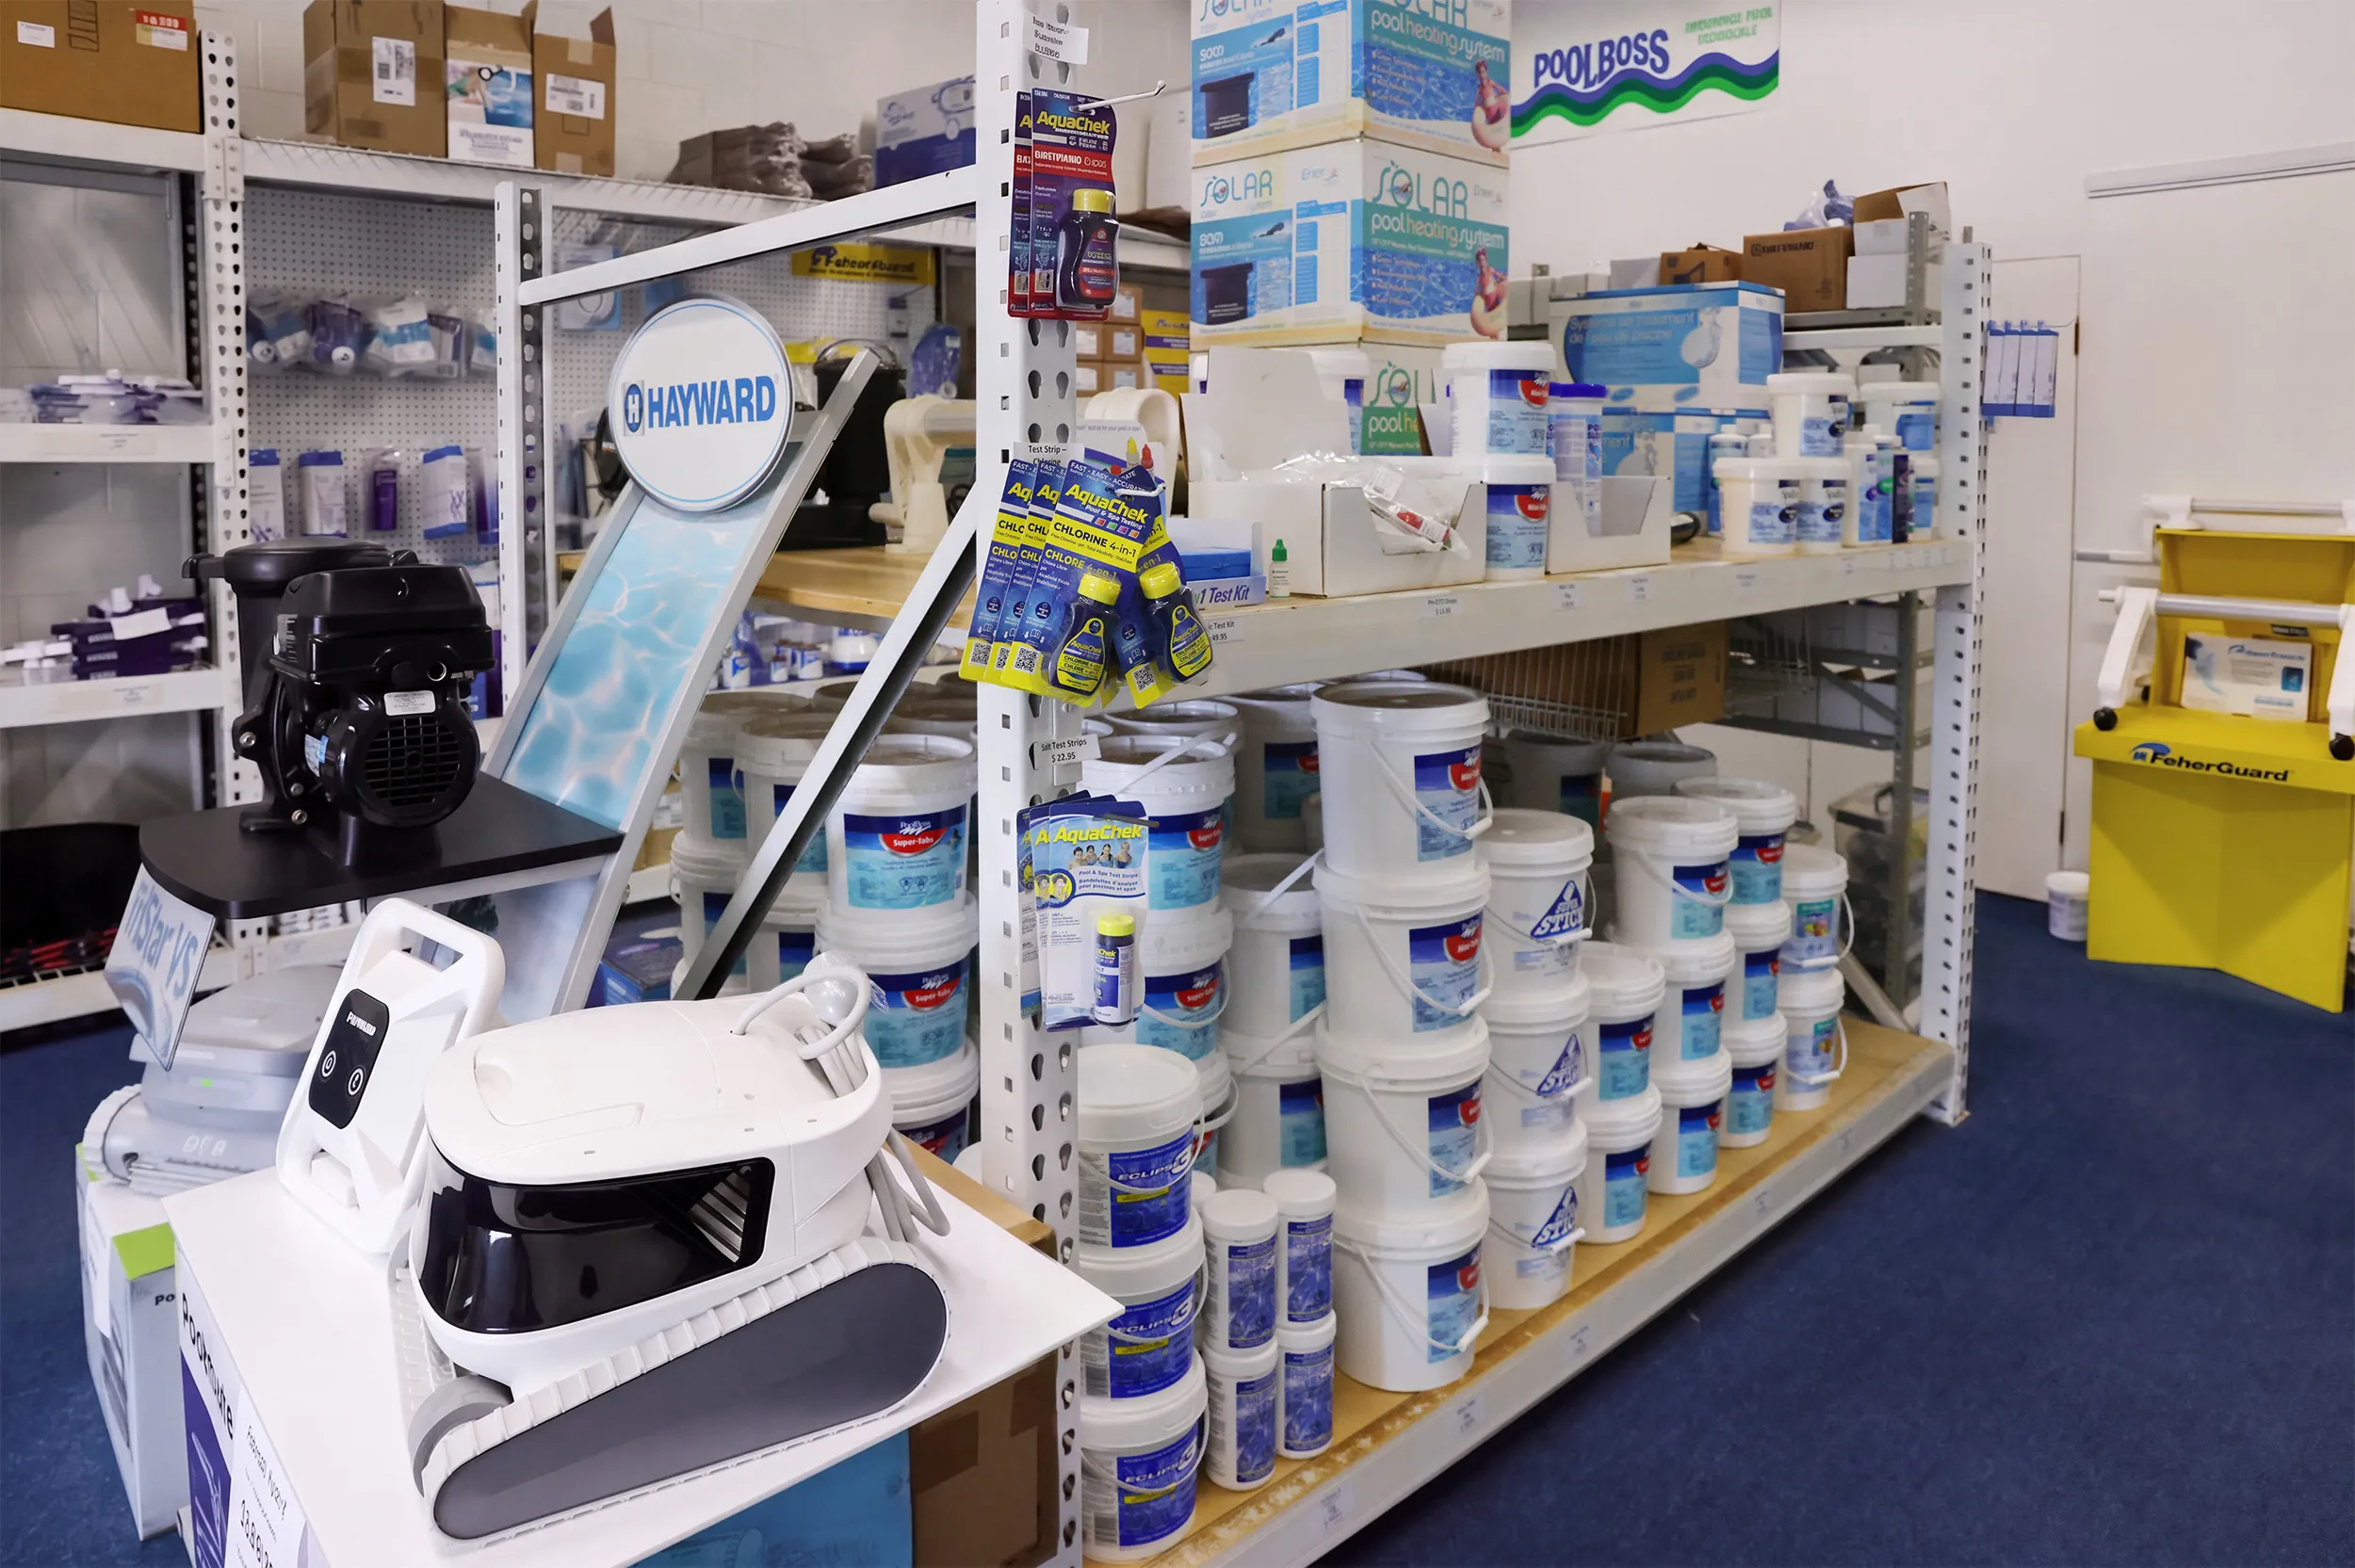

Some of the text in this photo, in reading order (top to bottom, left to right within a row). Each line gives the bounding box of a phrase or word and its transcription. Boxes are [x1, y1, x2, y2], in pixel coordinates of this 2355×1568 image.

[1372, 9, 1405, 34] pool
[1405, 13, 1458, 55] heating
[1458, 36, 1505, 63] system
[1036, 111, 1110, 135] AquaChek
[1200, 170, 1273, 207] SOLAR
[1372, 165, 1468, 219] SOLAR
[1372, 212, 1405, 234] pool
[1405, 216, 1458, 248] heating
[1459, 226, 1505, 251] system
[648, 376, 776, 428] HAYWARD
[1369, 412, 1403, 439] pool
[1028, 445, 1043, 453] Test
[1044, 445, 1061, 454] Strip
[1013, 462, 1029, 471] FAST
[1040, 463, 1056, 472] FAST
[1070, 462, 1087, 472] FAST
[1091, 470, 1109, 480] EASY
[1065, 483, 1150, 525] AquaChek
[1085, 504, 1100, 514] Pool
[1107, 511, 1119, 521] Spa
[1119, 515, 1144, 530] Testing
[1053, 522, 1137, 558] CHLORINE 4-in-1
[1045, 548, 1085, 569] CHLORE
[1210, 587, 1233, 604] Test
[1233, 585, 1250, 601] Kit
[1214, 622, 1226, 630] Test
[1071, 640, 1102, 654] AquaChek
[1211, 633, 1227, 641] 49.95
[1064, 655, 1089, 666] CHLORINE
[1064, 663, 1084, 672] CHLORE
[1041, 738, 1087, 752] Salt Test Strips
[1057, 752, 1076, 762] 22.95
[2151, 754, 2288, 782] FeherGuard
[893, 836, 934, 848] Super-Tabs
[1053, 823, 1144, 845] AquaChek
[166, 922, 199, 1000] VS
